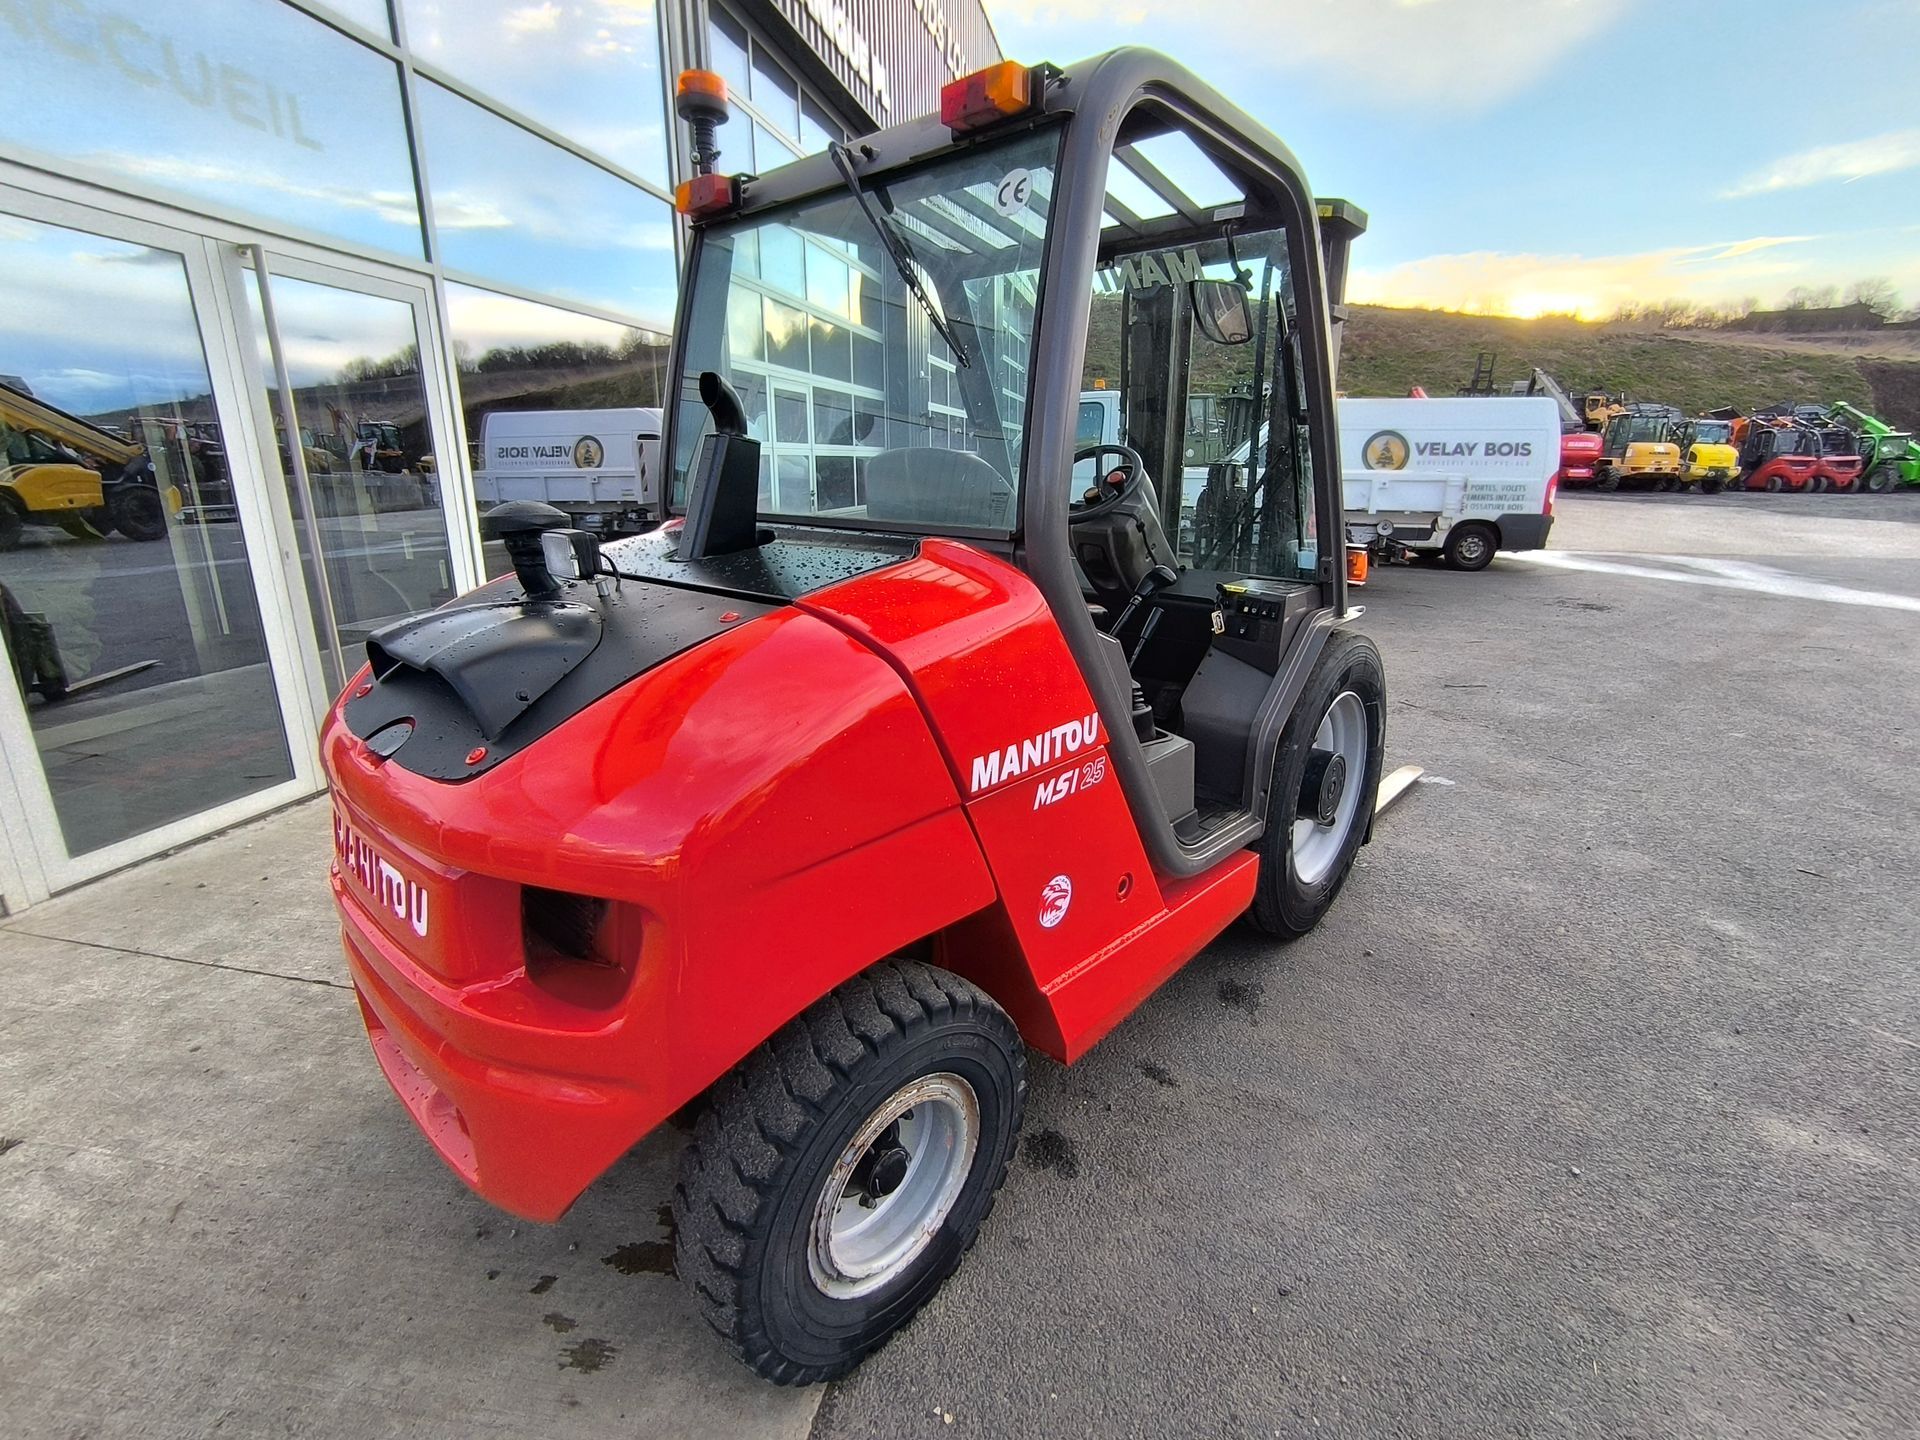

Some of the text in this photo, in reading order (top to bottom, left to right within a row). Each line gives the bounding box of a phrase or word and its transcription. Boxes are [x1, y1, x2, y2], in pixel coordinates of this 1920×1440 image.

[998, 177, 1027, 207] CE
[1415, 441, 1532, 457] VELAY BOIS
[971, 711, 1099, 793] MANITOU
[1033, 756, 1106, 811] MSI 25
